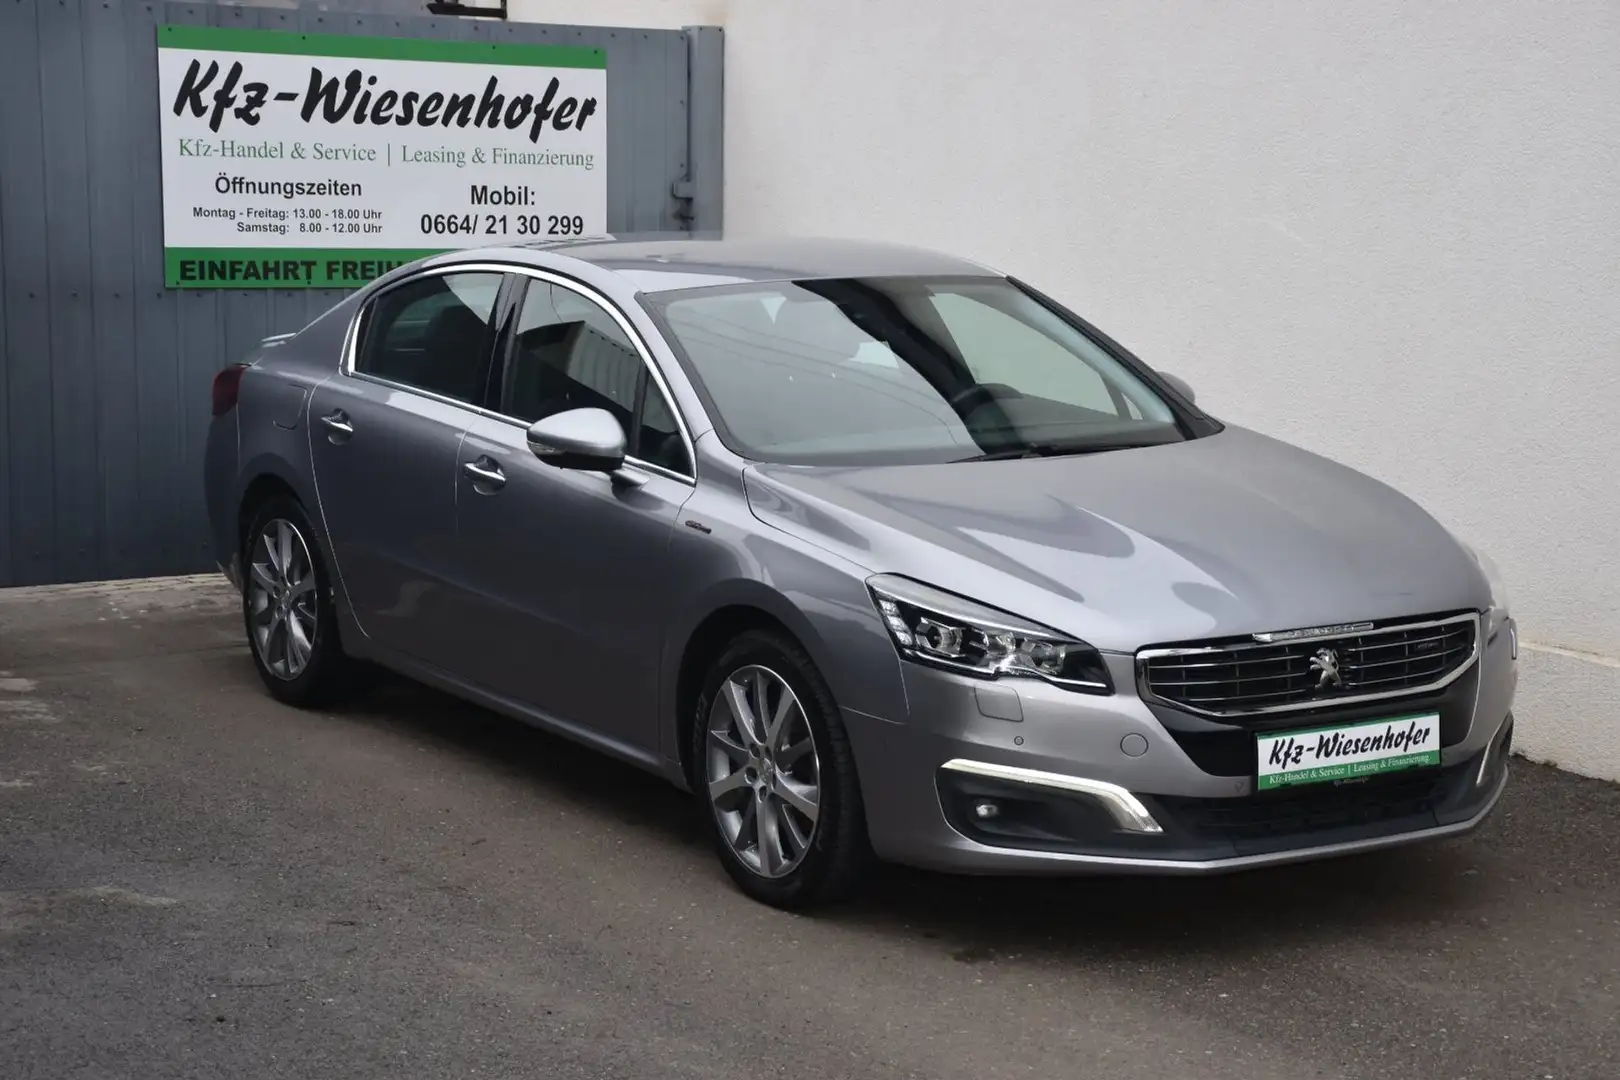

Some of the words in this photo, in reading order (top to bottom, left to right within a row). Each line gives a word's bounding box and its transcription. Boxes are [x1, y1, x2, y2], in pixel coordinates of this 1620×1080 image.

[172, 58, 598, 144] Kfz-Wiesenhofer
[178, 138, 284, 159] Kfz-Handel
[290, 142, 306, 160] &
[313, 142, 377, 161] Service
[402, 145, 466, 168] Leasing
[472, 147, 487, 164] &
[492, 147, 594, 171] Finanzierung
[215, 172, 362, 199] Öffnungszeiten
[470, 184, 535, 206] Mobil:
[193, 207, 236, 220] Montag
[246, 208, 290, 221] Freitag:
[293, 208, 321, 219] 13.00
[332, 208, 360, 219] 18.00
[363, 209, 383, 219] Uhr
[420, 213, 479, 235] 0664/
[485, 214, 508, 235] 21
[517, 215, 541, 236] 30
[547, 215, 584, 236] 299
[236, 221, 290, 235] Samstag:
[299, 222, 321, 233] 8.00
[332, 222, 360, 233] 12.00
[363, 223, 383, 233] Uhr
[179, 259, 317, 281] EINFAHRT
[1268, 721, 1431, 770] Kfz-Wiesenhofer
[1269, 769, 1310, 785] Kfz-Handel
[1310, 769, 1317, 778] &
[1318, 766, 1345, 777] Service
[1353, 762, 1380, 773] Leasing
[1379, 761, 1386, 769] &
[1387, 753, 1430, 767] Finanzierung
